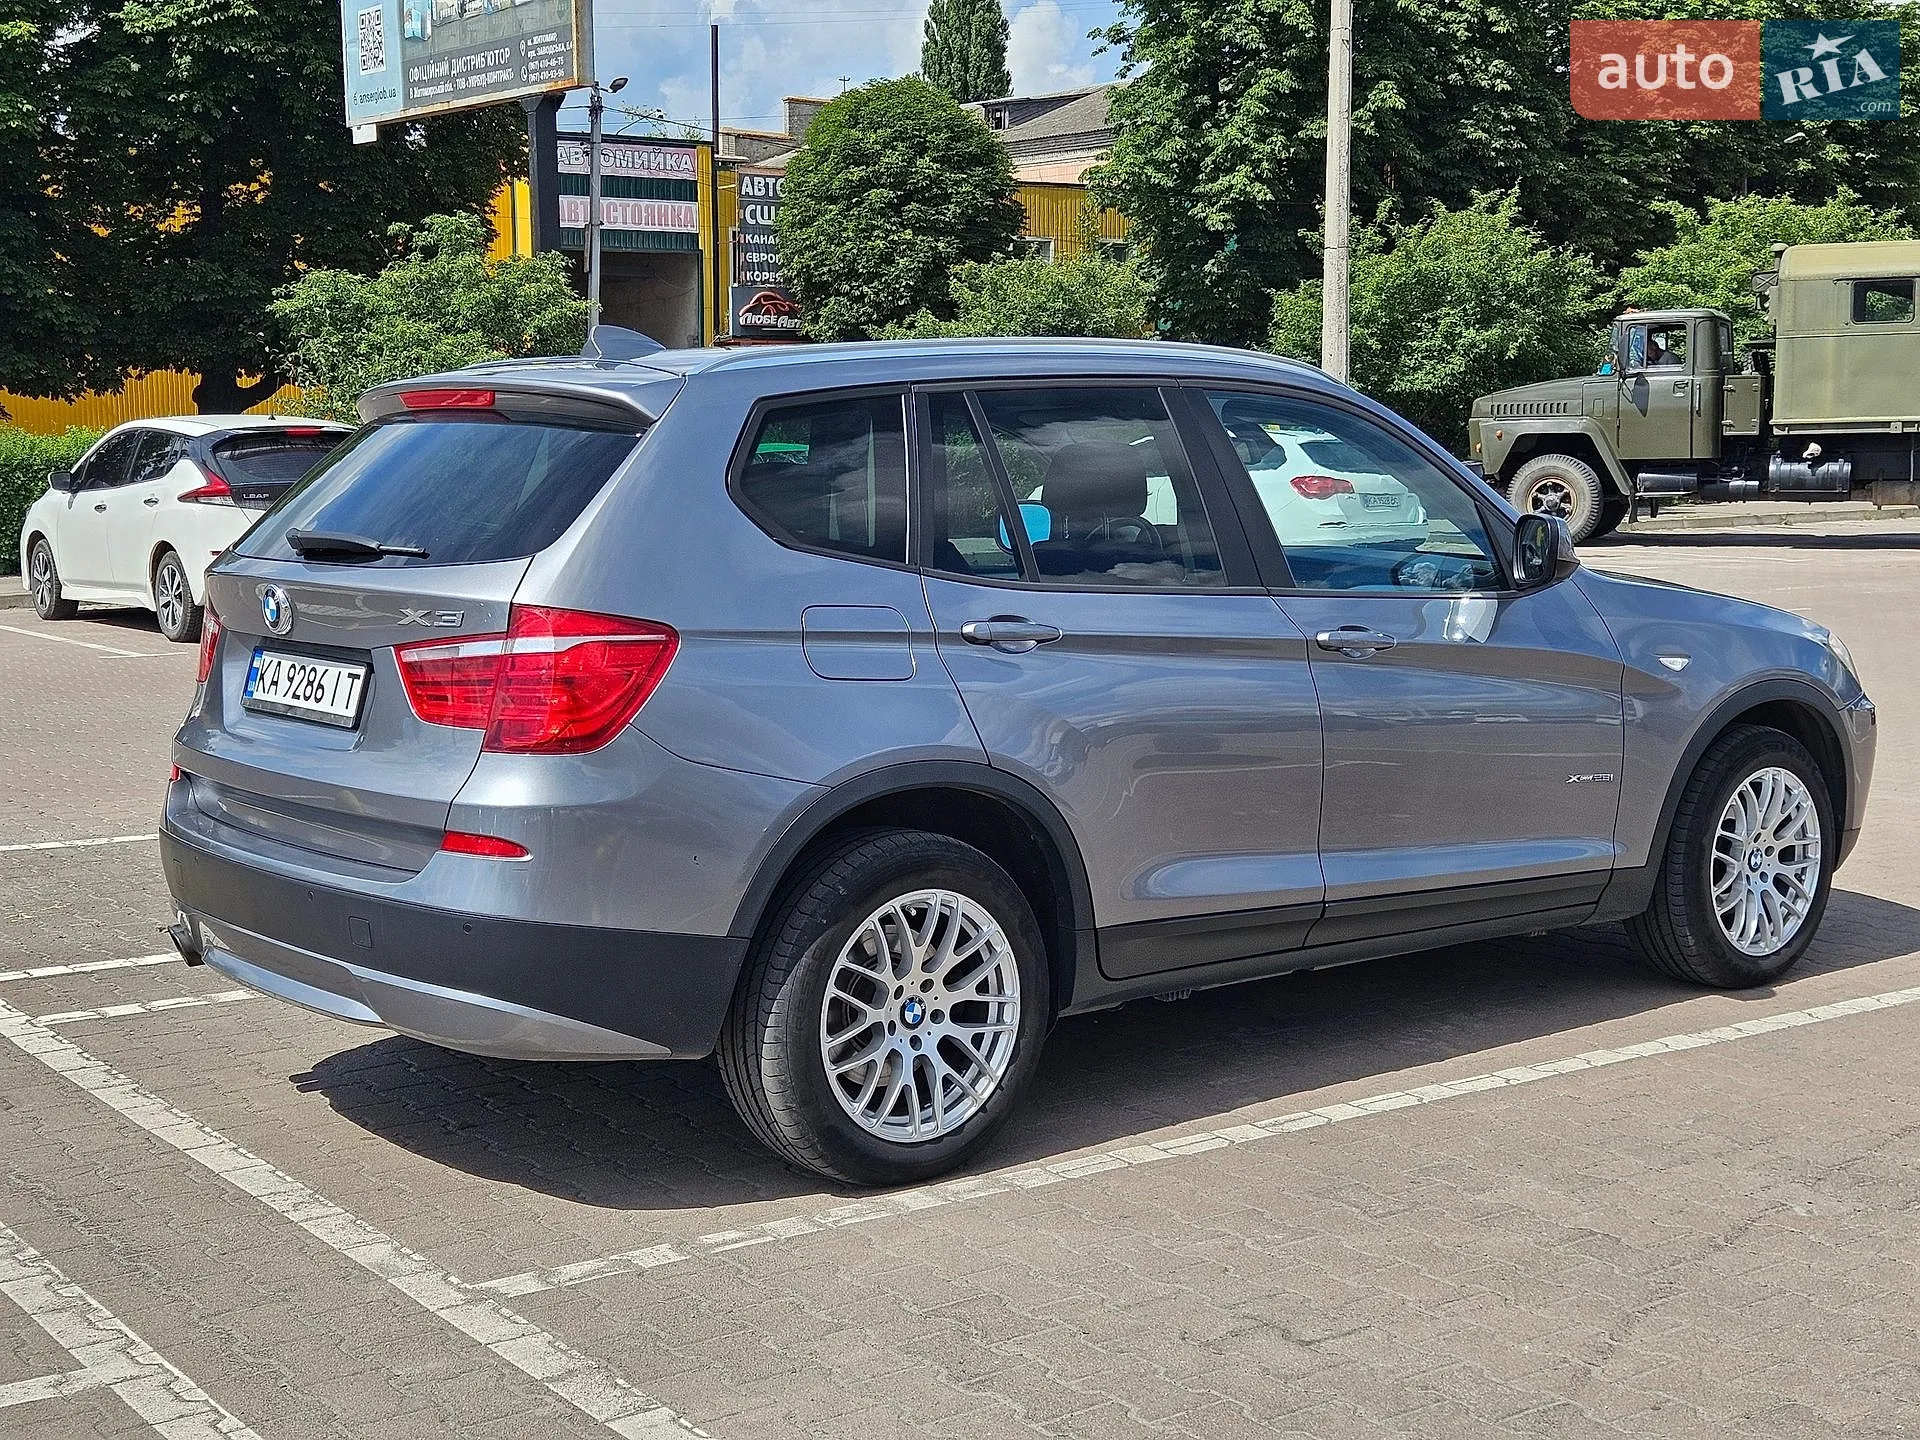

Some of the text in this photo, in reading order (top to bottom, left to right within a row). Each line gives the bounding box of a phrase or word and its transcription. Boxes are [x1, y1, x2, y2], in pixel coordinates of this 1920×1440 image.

[408, 47, 511, 83] ОФІЦІЙНИЙ ДИСТРИБ'ЮТОР
[741, 175, 788, 197] АВТО
[745, 204, 777, 226] СШ
[745, 233, 776, 245] КАНА
[746, 252, 779, 264] ЄВРО
[777, 315, 802, 329] АВТ
[397, 607, 465, 628] X3
[256, 658, 361, 710] KA 9286 IT
